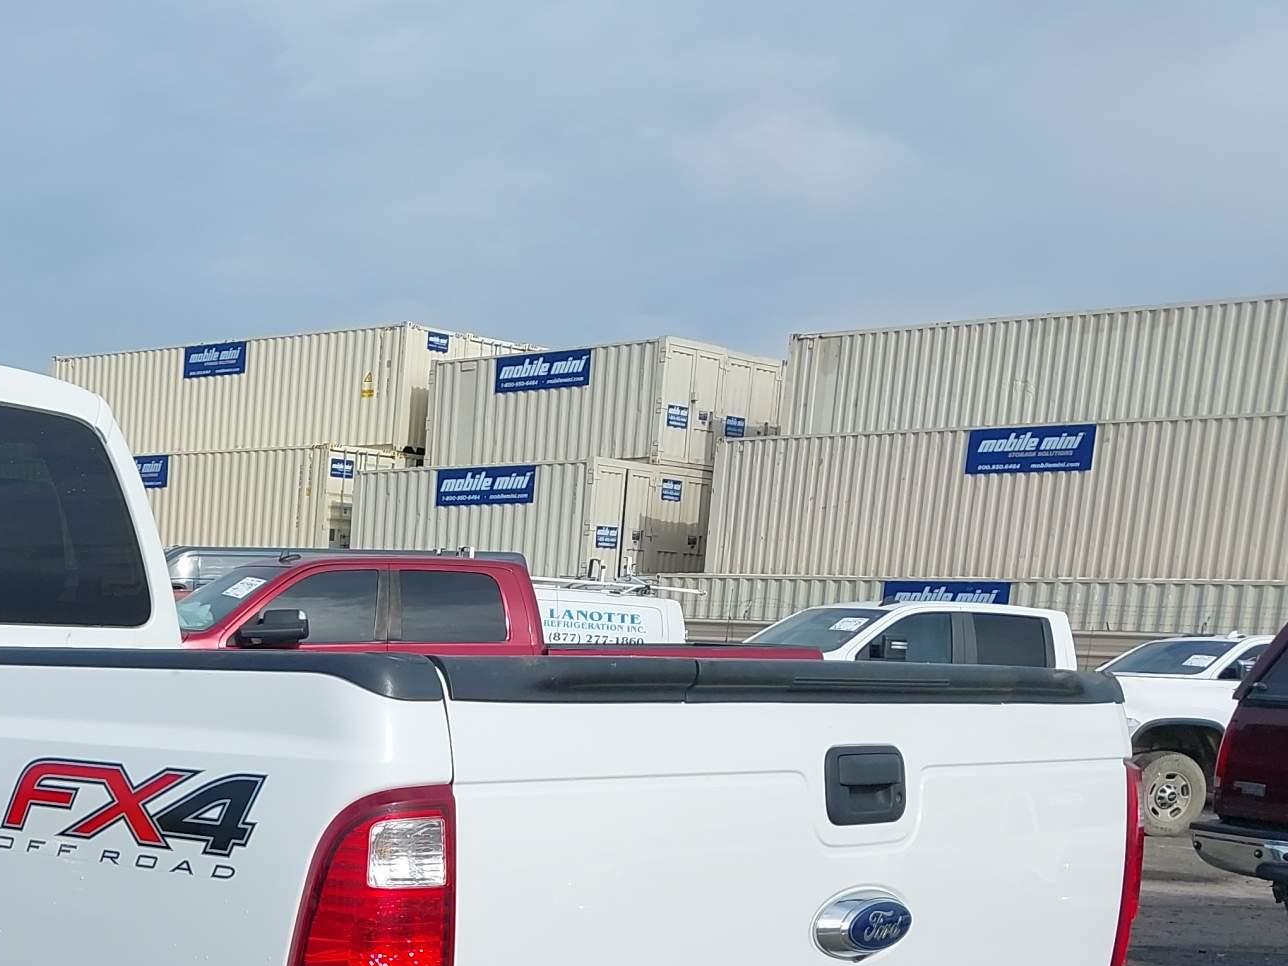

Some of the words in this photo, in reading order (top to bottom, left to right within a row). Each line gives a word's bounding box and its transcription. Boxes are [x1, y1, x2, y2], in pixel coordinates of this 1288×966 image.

[189, 347, 219, 364] mobile
[219, 346, 242, 360] mini
[499, 357, 550, 380] mobile
[550, 355, 588, 375] mini
[977, 431, 1039, 453] mobile
[1039, 431, 1085, 451] mini
[440, 471, 493, 492] mobile
[493, 471, 533, 490] mini
[955, 589, 999, 603] mini
[543, 619, 625, 633] REFRIGERATION
[626, 624, 647, 634] INC.
[548, 608, 642, 625] LANOTTE
[548, 631, 582, 645] (877)
[585, 634, 645, 646] 277-1860
[0, 757, 269, 858] FX4
[99, 849, 237, 880] ROAD
[863, 909, 909, 942] Ford
